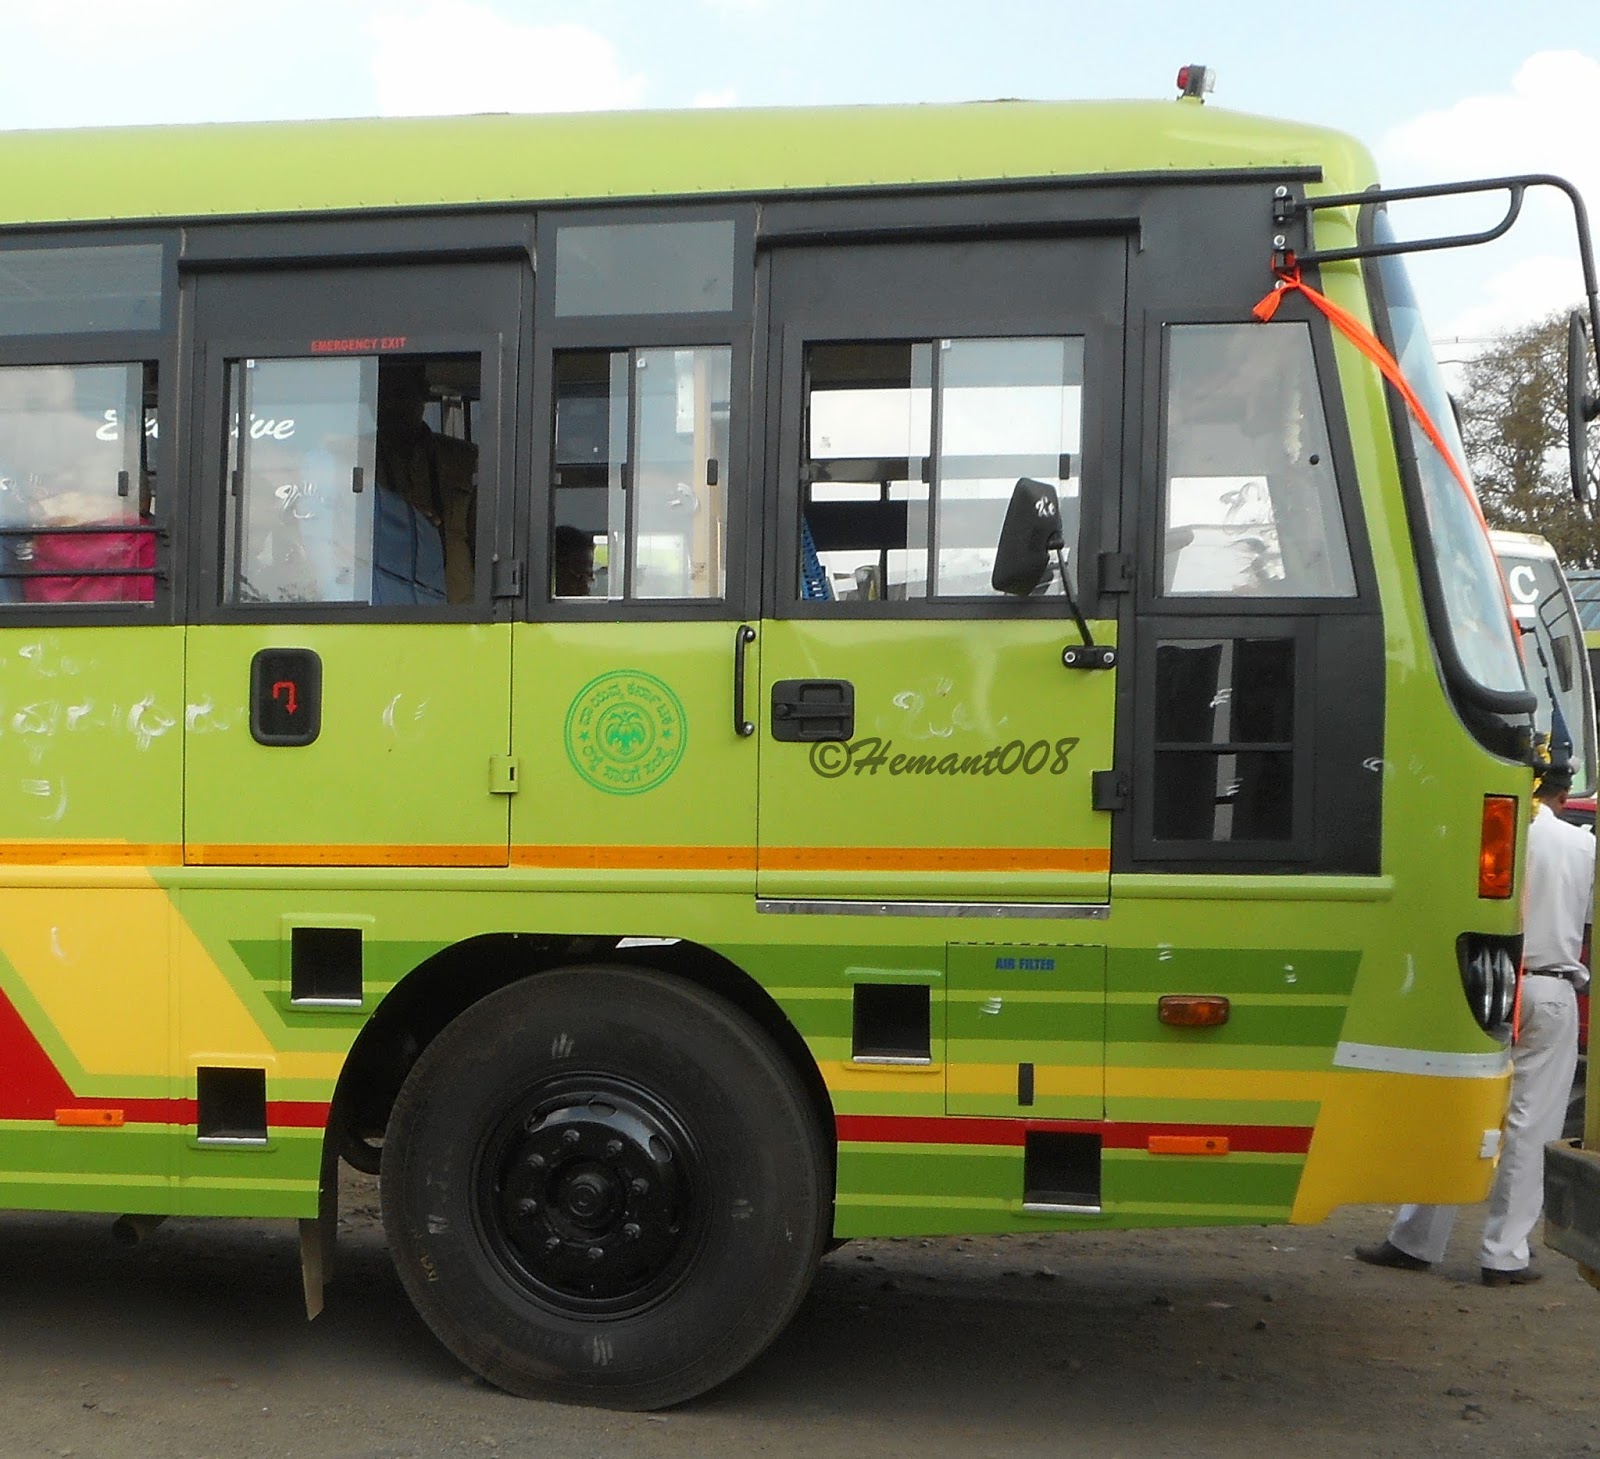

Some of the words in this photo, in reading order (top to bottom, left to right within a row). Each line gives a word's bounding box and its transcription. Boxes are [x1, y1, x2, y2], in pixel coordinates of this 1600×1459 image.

[311, 338, 378, 353] EMERGENCY
[381, 336, 407, 350] EXIT
[995, 957, 1016, 971] AIR
[1019, 957, 1056, 971] FILTER
